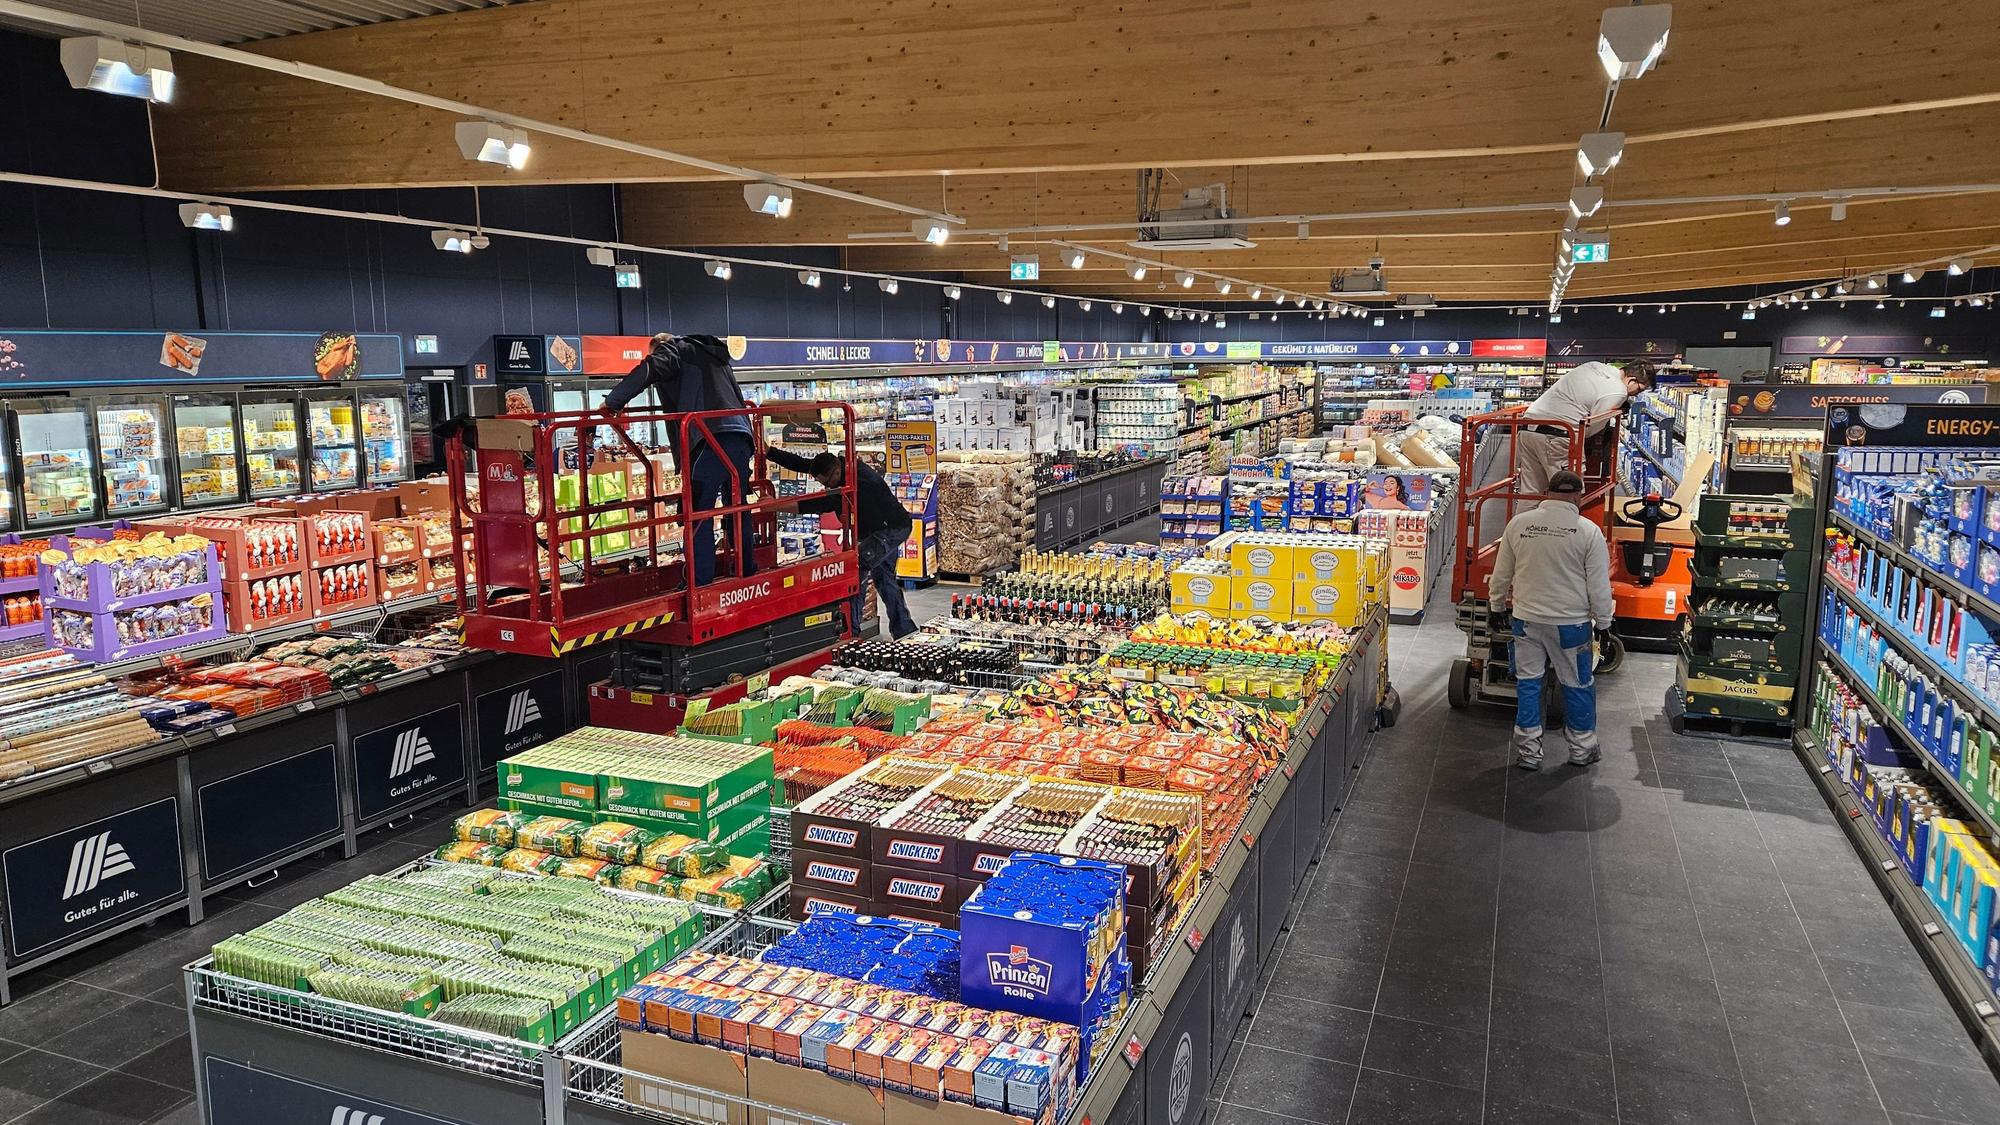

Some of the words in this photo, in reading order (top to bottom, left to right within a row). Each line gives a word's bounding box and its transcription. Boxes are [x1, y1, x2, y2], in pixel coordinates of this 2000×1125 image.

[806, 346, 839, 361] SCHNELL
[840, 347, 845, 360] &
[846, 346, 871, 360] LECKER
[1272, 343, 1306, 355] GEKÜHLT
[1307, 344, 1313, 354] &
[1314, 343, 1358, 354] NATÜRLICH
[1926, 419, 2000, 436] ENERGY-
[1232, 457, 1259, 466] HARIBO
[811, 561, 845, 583] MAGNI
[1393, 574, 1421, 583] MIKADO
[719, 581, 771, 608] ES0807AC
[1722, 685, 1758, 695] JACOBS
[504, 741, 522, 751] Gutes
[390, 784, 411, 797] Gutes
[423, 773, 438, 785] alle.
[507, 790, 537, 801] GESCHMACK
[536, 795, 546, 803] MIT
[546, 796, 563, 805] GUTEM
[673, 799, 691, 808] SAUCEN
[707, 799, 732, 820] GESCHMACK
[732, 794, 740, 806] MIT
[740, 787, 754, 801] GUTEM
[608, 803, 639, 815] GESCHMACK
[639, 807, 650, 817] MIT
[649, 808, 667, 819] GUTEM
[808, 827, 855, 845] SNICKERS
[891, 842, 940, 861] SNICKERS
[977, 856, 1006, 872] SNIC
[809, 864, 856, 883] SNICKERS
[891, 880, 941, 899] SNICKERS
[64, 905, 98, 923] Gutes
[99, 896, 116, 911] für
[117, 889, 139, 904] alle.
[991, 960, 1046, 988] Prinzen
[1003, 986, 1035, 1001] Rolle
